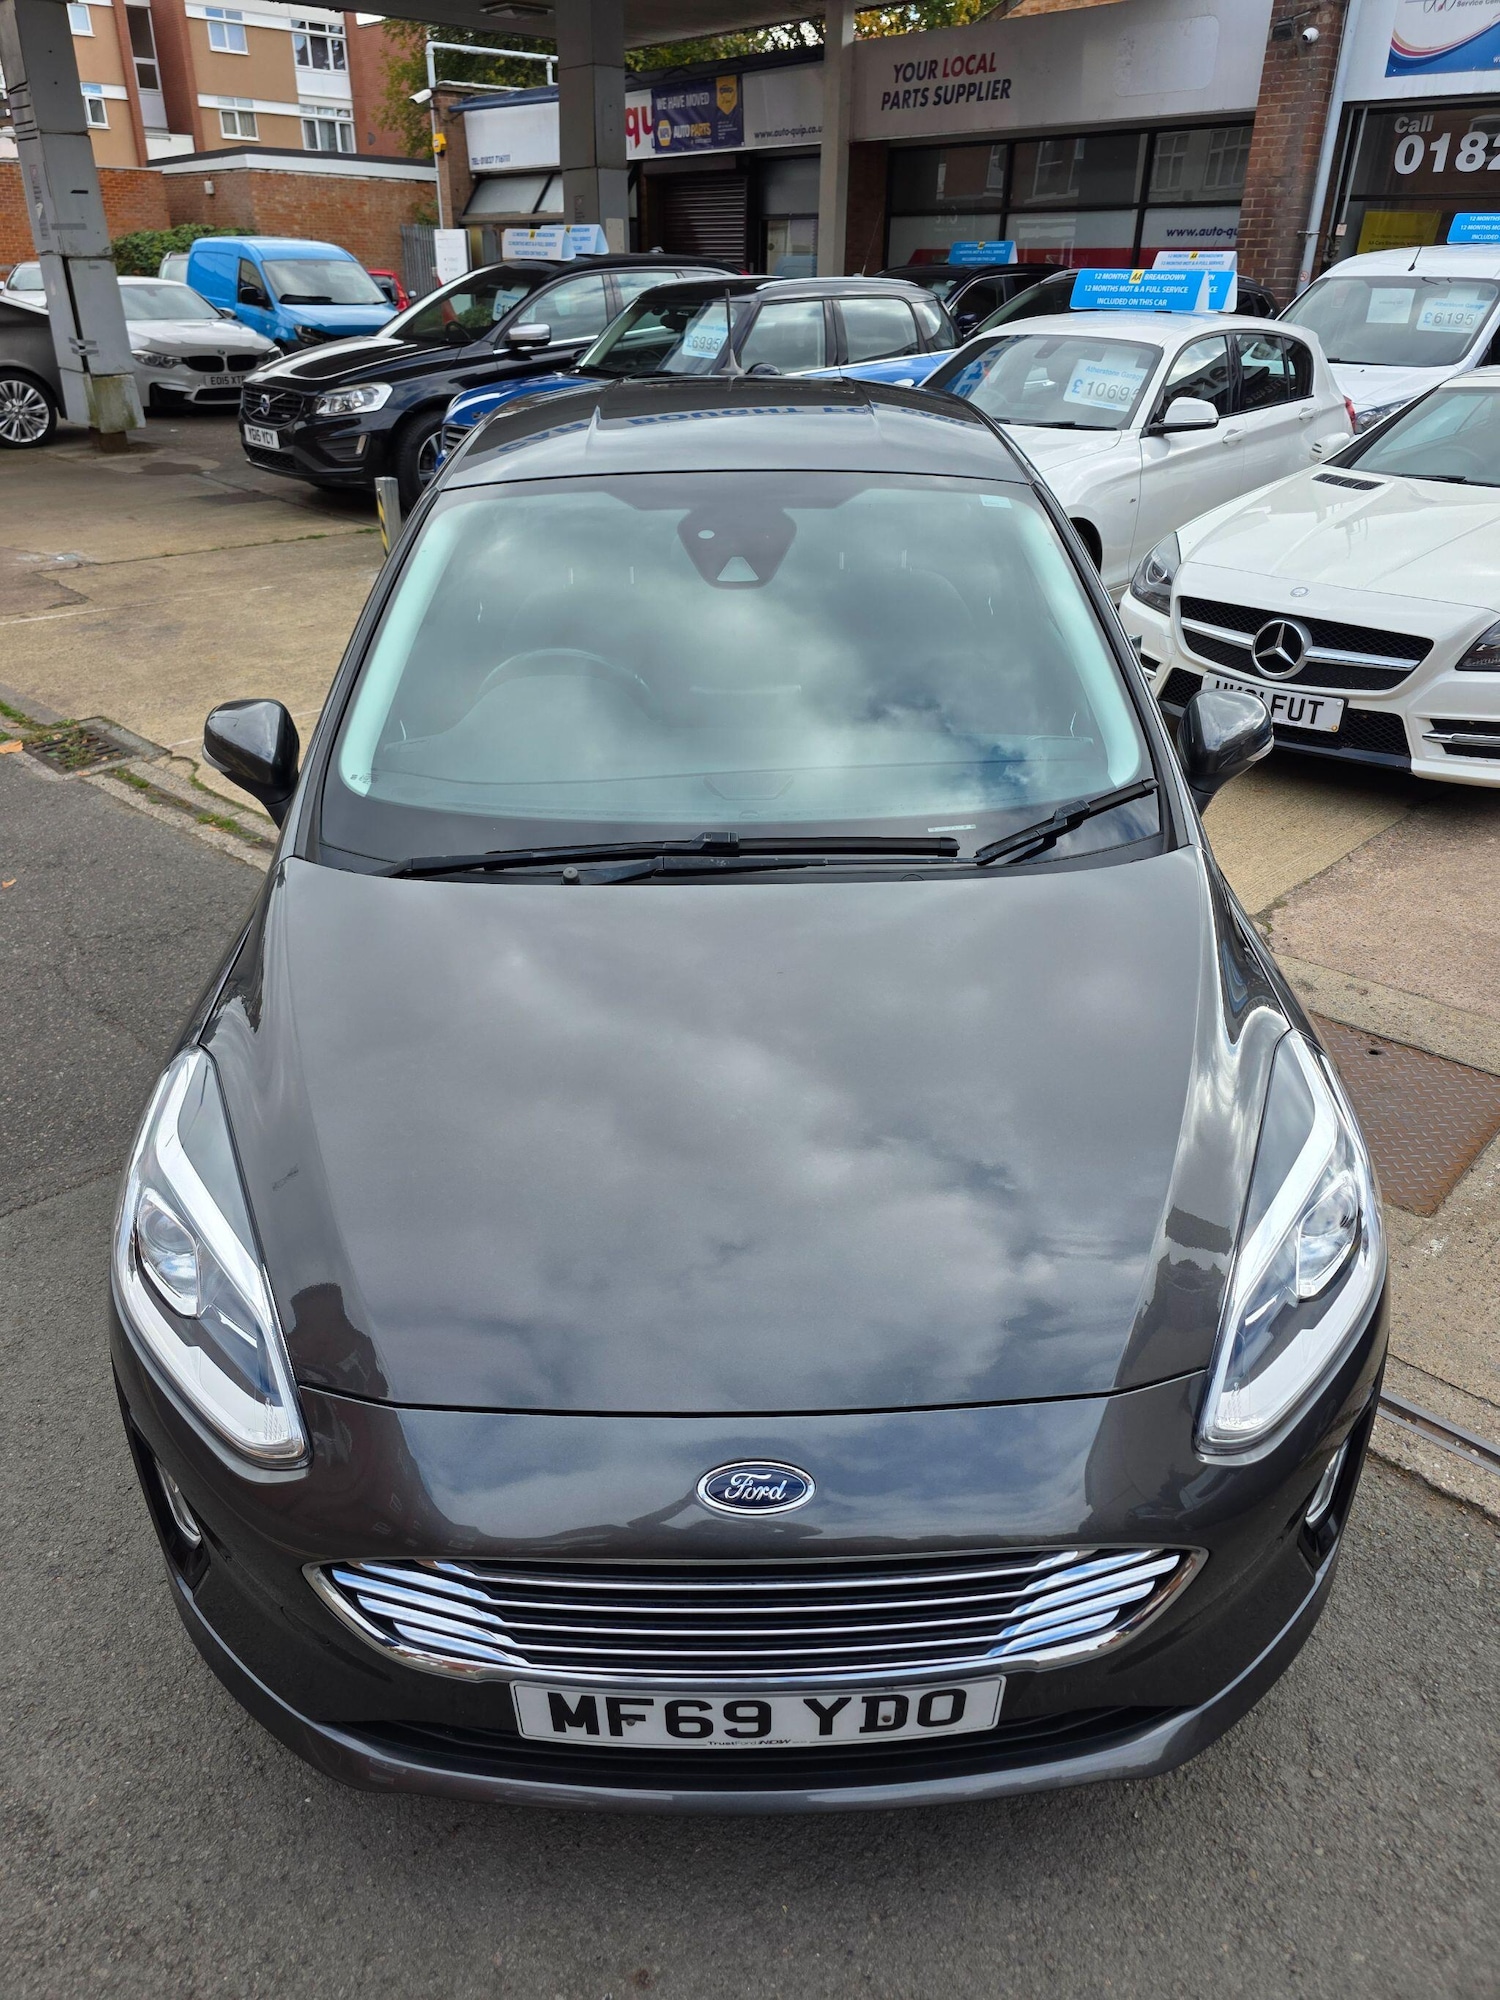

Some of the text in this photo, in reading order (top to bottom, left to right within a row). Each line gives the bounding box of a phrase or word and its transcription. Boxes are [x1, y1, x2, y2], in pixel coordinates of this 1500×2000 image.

[893, 52, 997, 84] YOUR LOCAL
[656, 98, 667, 110] WE
[668, 95, 685, 108] HAVE
[686, 92, 710, 107] MOVED
[881, 78, 1012, 111] PARTS SUPPLIER
[673, 124, 690, 138] AUTO
[690, 122, 711, 137] PARTS
[1394, 115, 1434, 134] Call
[1131, 272, 1142, 280] AA
[1144, 273, 1187, 281] BREAKDOWN
[1092, 285, 1119, 293] MONTHS
[1161, 286, 1189, 294] SERVICE
[1096, 297, 1128, 305] INCLUDED
[1423, 311, 1475, 326] £6195
[686, 334, 721, 352] £6995
[1085, 365, 1120, 377] Atherstone
[1271, 694, 1325, 724] FUT
[724, 1472, 788, 1500] Ford
[547, 1688, 967, 1739] MF69 YDO
